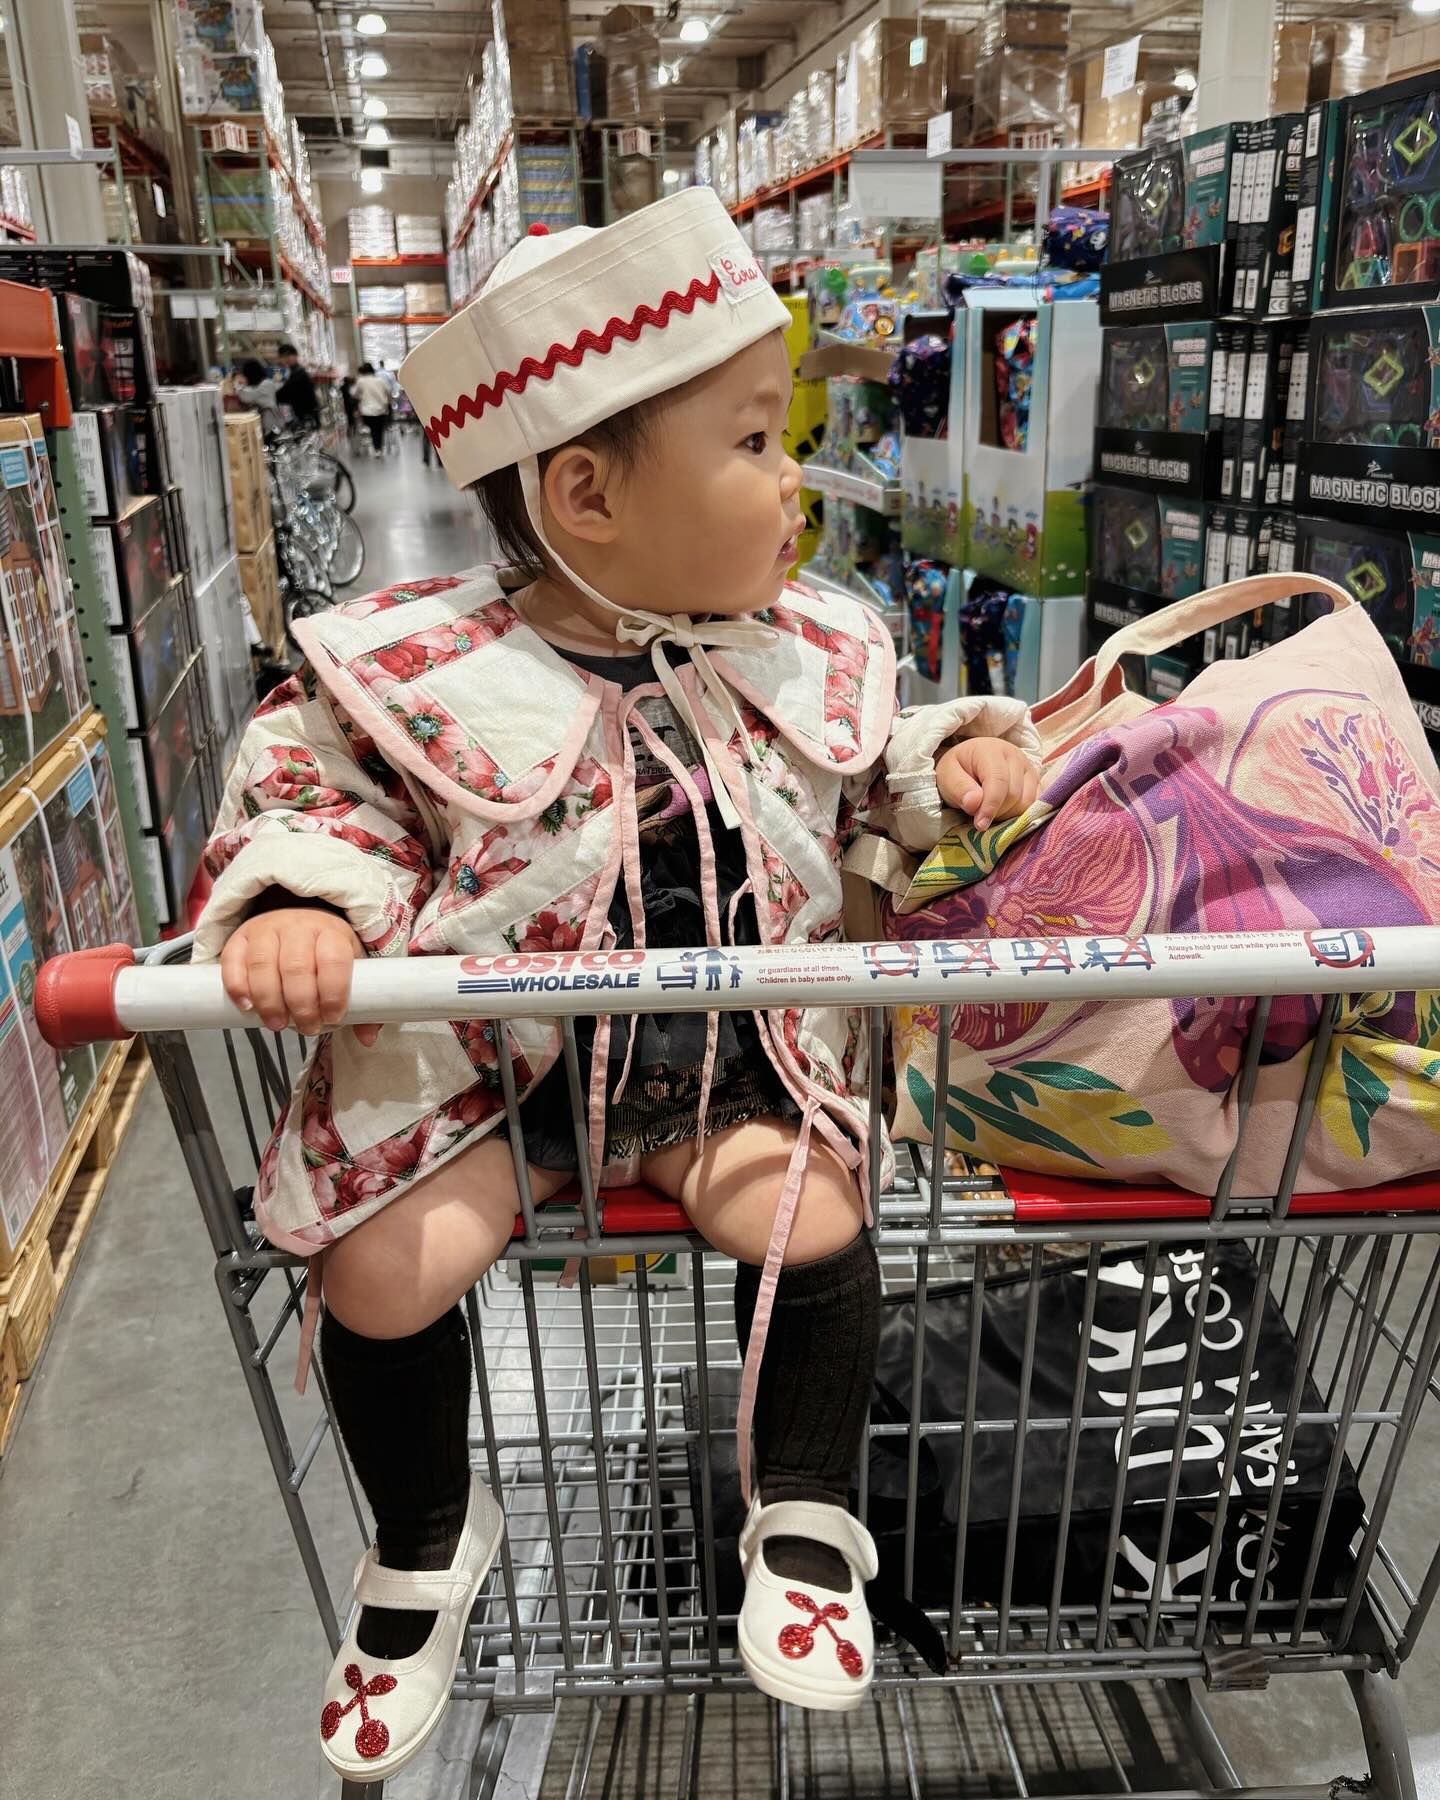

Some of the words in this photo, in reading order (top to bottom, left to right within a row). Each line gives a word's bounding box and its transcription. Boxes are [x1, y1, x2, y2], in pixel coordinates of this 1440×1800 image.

[1109, 287, 1159, 312] MAGNETIC
[1160, 281, 1203, 307] BLOCKS
[1309, 475, 1389, 507] MAGNETIC
[1389, 483, 1440, 514] BLOC
[1195, 943, 1211, 951] hold
[459, 951, 647, 976] COSTCO
[767, 966, 801, 975] guardians
[811, 965, 820, 973] all
[511, 973, 640, 993] WHOLESALE
[799, 975, 815, 984] baby
[836, 974, 854, 983] only.
